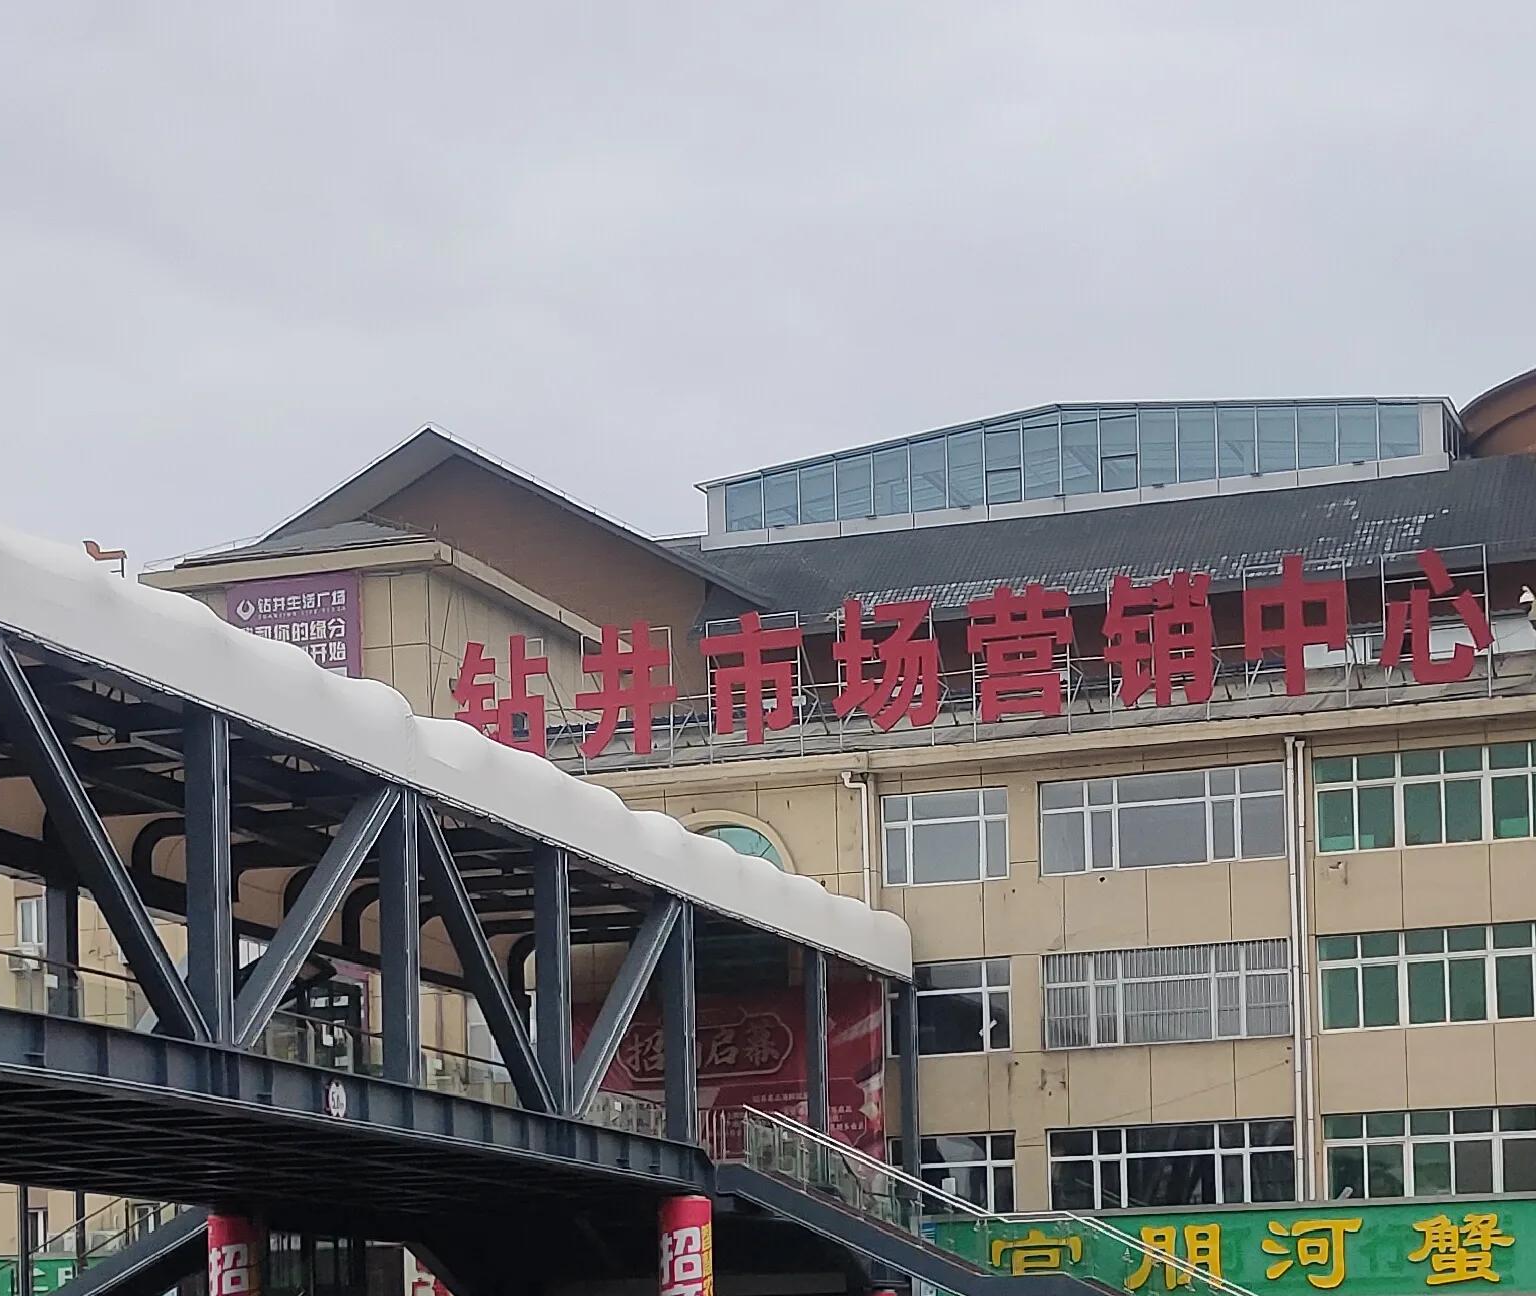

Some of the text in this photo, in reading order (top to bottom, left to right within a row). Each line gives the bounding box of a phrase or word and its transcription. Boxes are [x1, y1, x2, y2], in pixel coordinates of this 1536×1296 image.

[257, 588, 346, 615] 钻井生活广场
[452, 547, 1495, 760] 钻井市场营销中心
[626, 1022, 781, 1075] 招启幕
